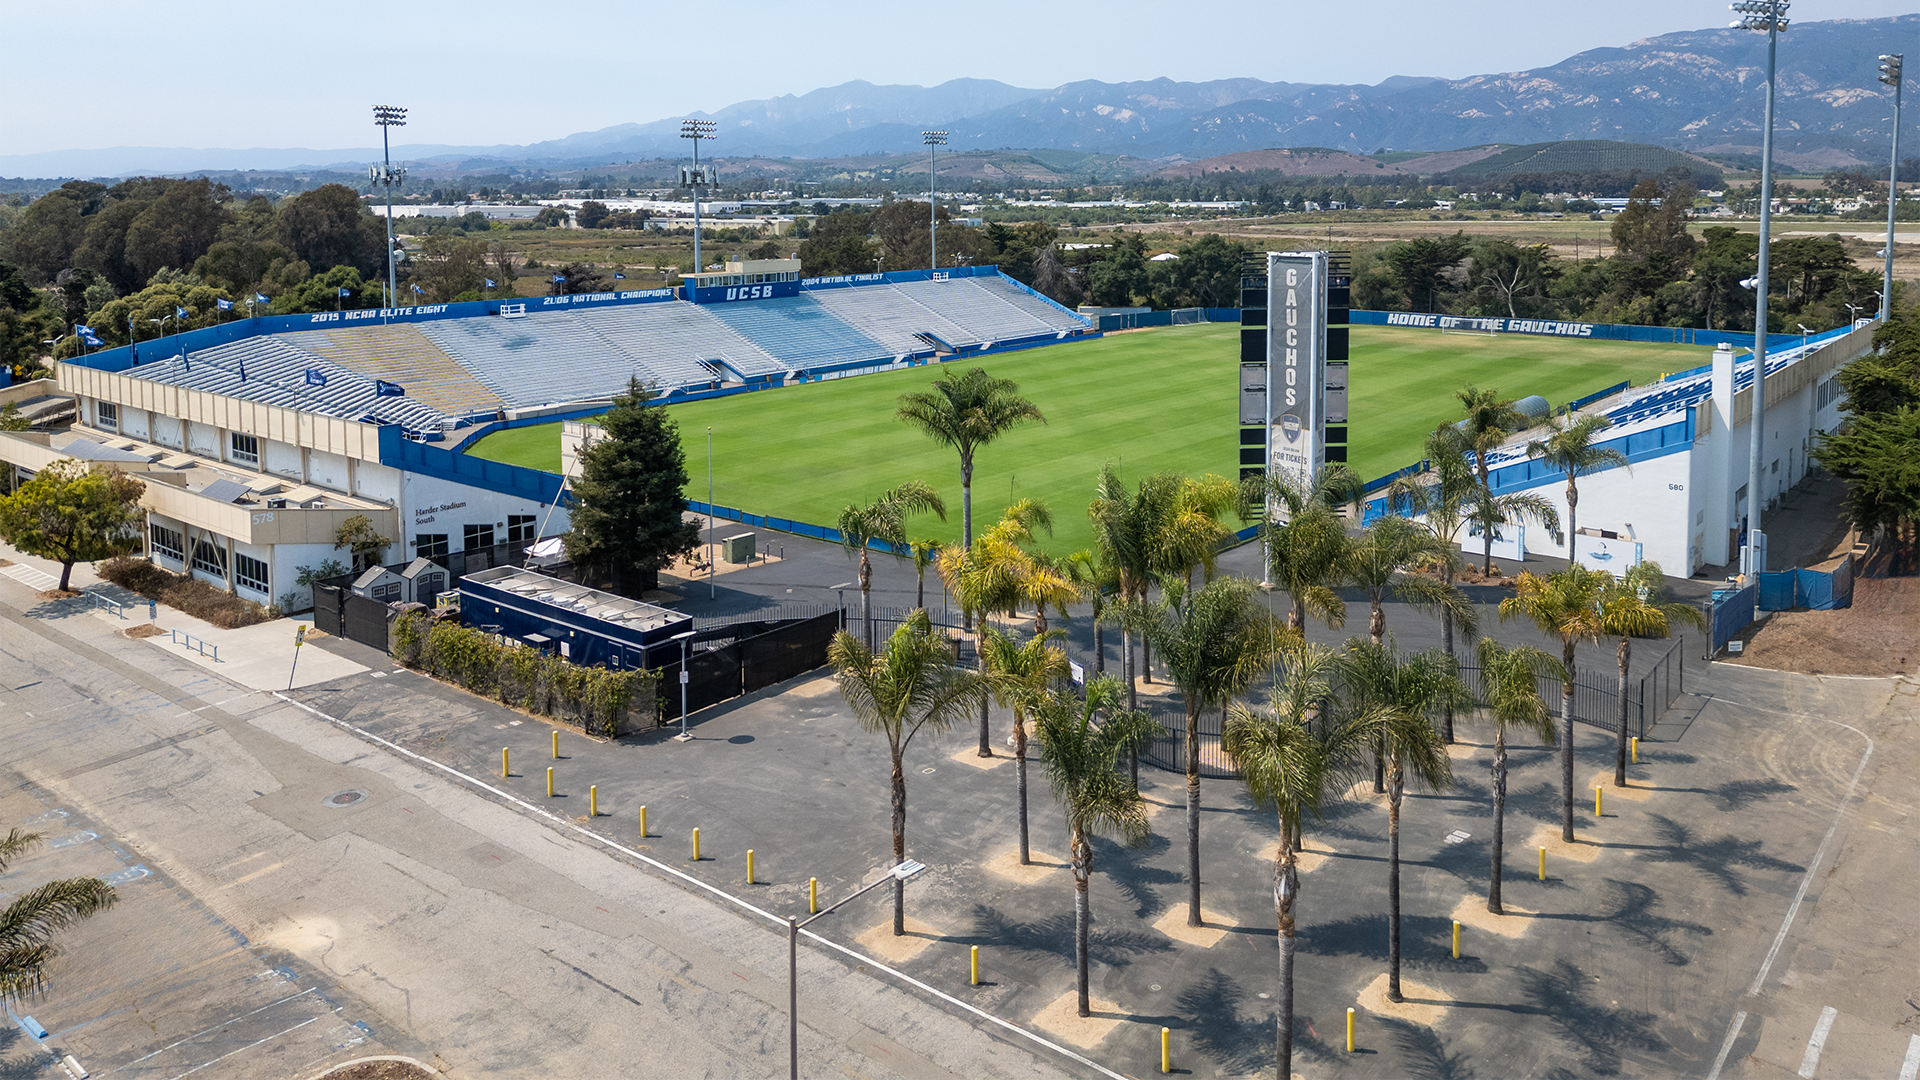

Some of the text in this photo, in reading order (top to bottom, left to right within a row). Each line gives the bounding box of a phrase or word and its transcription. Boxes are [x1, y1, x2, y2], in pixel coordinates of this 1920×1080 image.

[801, 273, 884, 286] 2004 NATIONAL FINALIST
[572, 292, 618, 303] NATIONAL
[621, 288, 672, 299] CHAMPIONS
[726, 285, 773, 301] UCSB
[345, 309, 376, 321] NCAA
[379, 306, 413, 318] ELITE
[416, 304, 449, 315] EIGHT
[1387, 313, 1436, 327] HOME
[1439, 316, 1461, 328] OF
[1507, 319, 1594, 336] GAUCHOS
[1285, 268, 1298, 406] GAUCHOS
[1272, 451, 1285, 461] FOR
[1668, 483, 1684, 492] 580
[415, 501, 467, 516] Harder Stadium
[252, 511, 275, 525] 578
[415, 515, 435, 525] South
